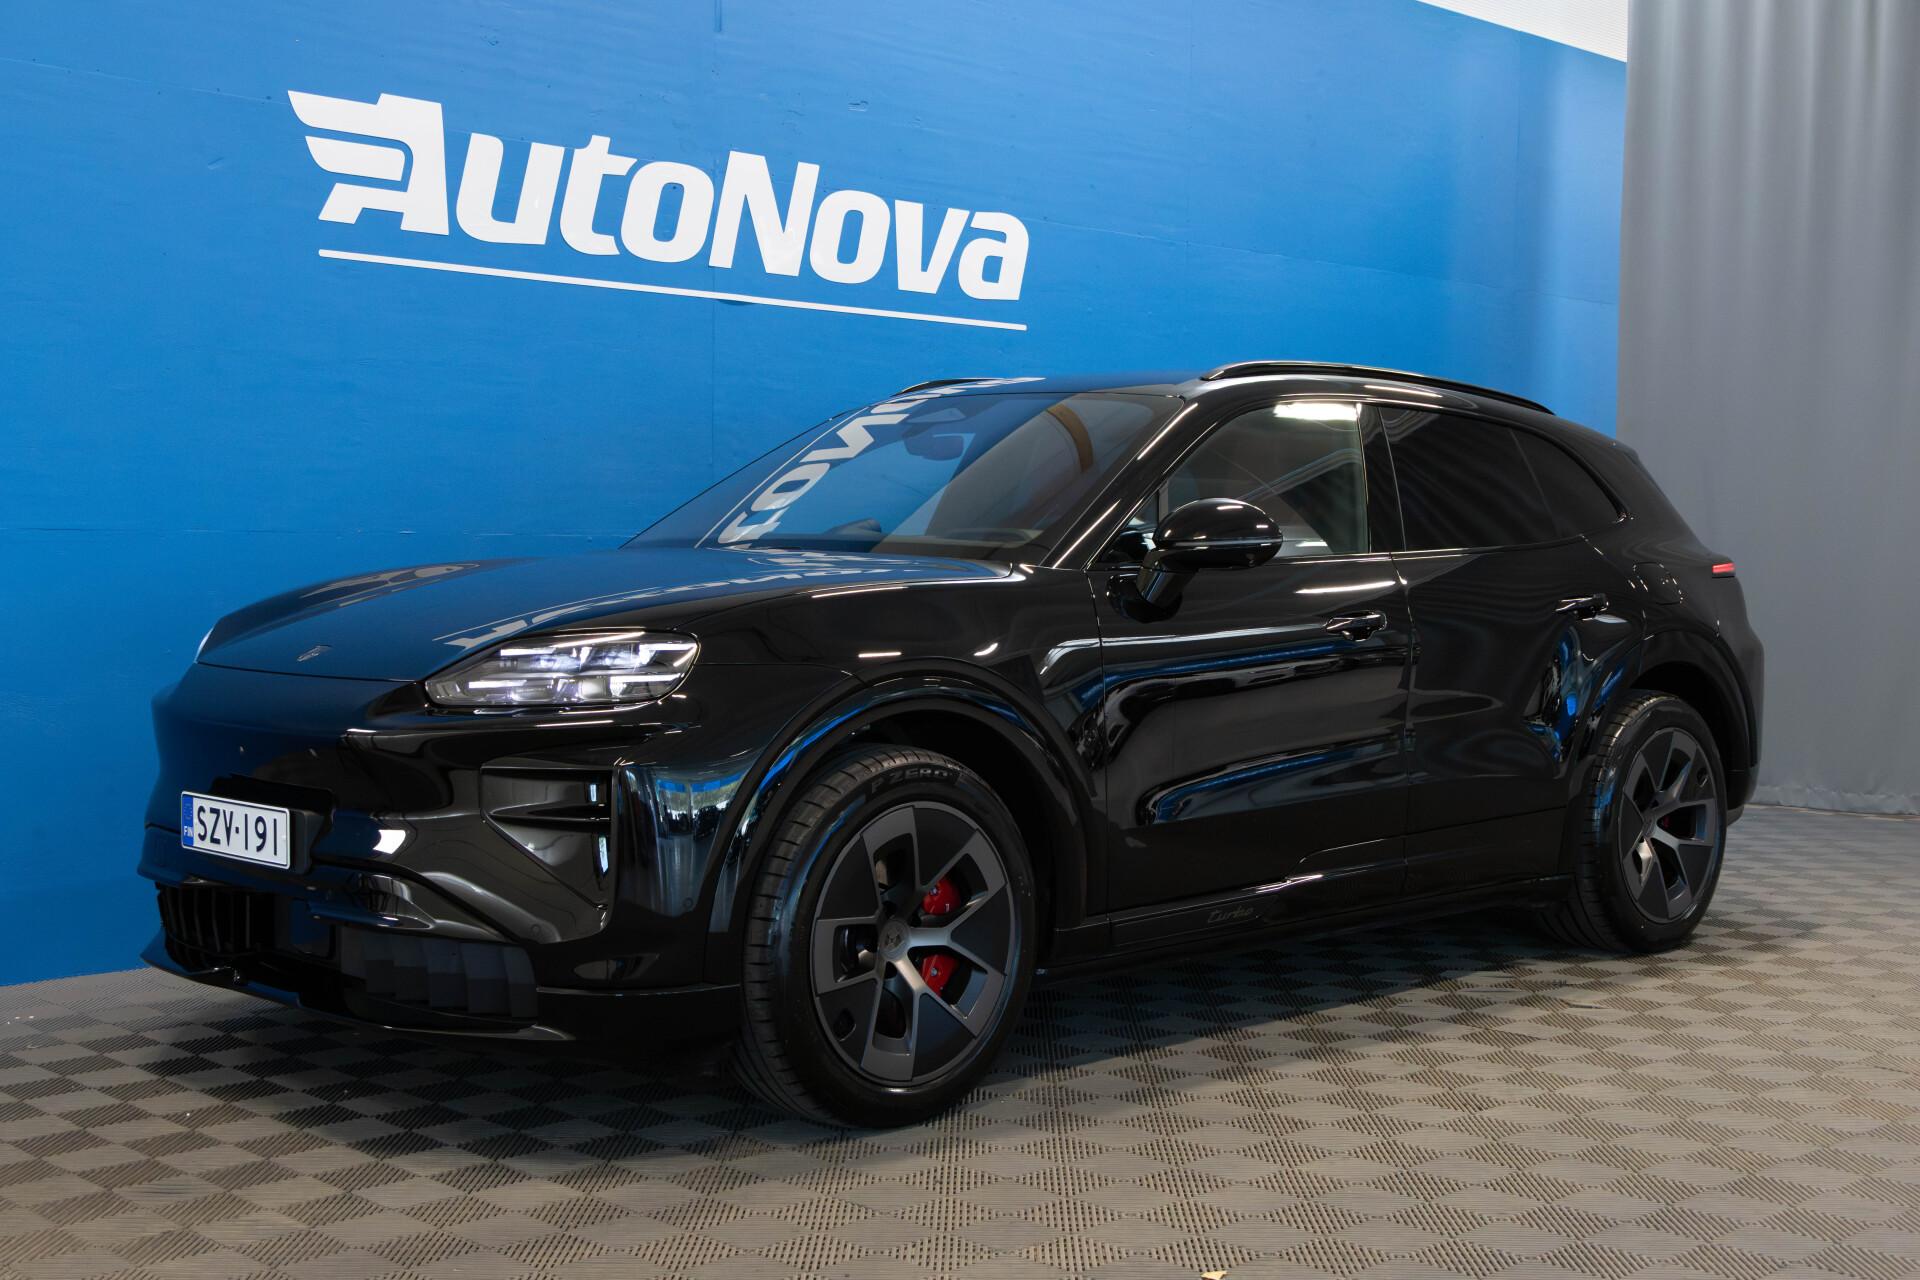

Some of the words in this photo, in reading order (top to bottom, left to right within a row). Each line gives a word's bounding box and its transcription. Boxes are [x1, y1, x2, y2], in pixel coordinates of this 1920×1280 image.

[288, 90, 1030, 301] AutoNova
[889, 768, 948, 785] ZERO
[197, 805, 278, 856] SZV-191
